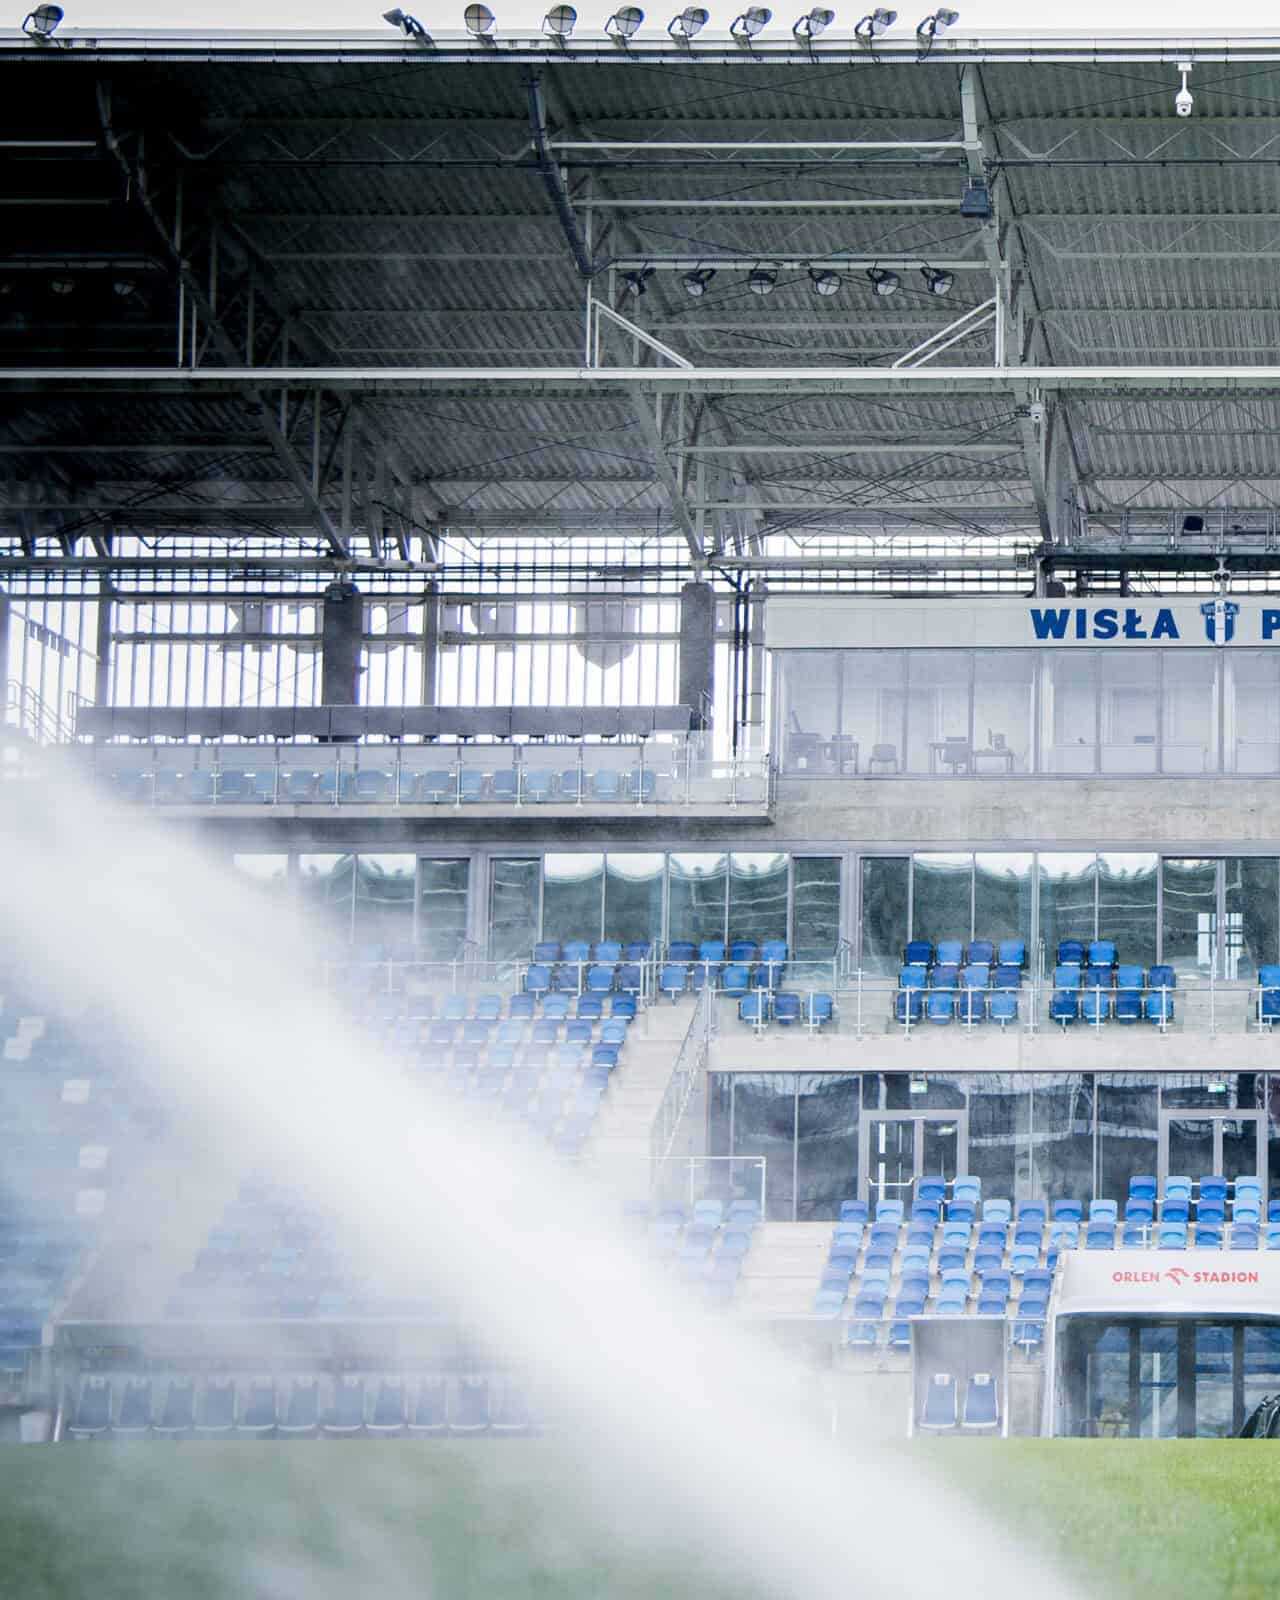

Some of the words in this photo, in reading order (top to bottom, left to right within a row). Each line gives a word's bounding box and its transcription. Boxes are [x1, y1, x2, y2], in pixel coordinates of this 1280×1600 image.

[1031, 608, 1180, 640] WISŁA
[1112, 1271, 1160, 1283] ORLEN
[1193, 1271, 1259, 1283] STADION
